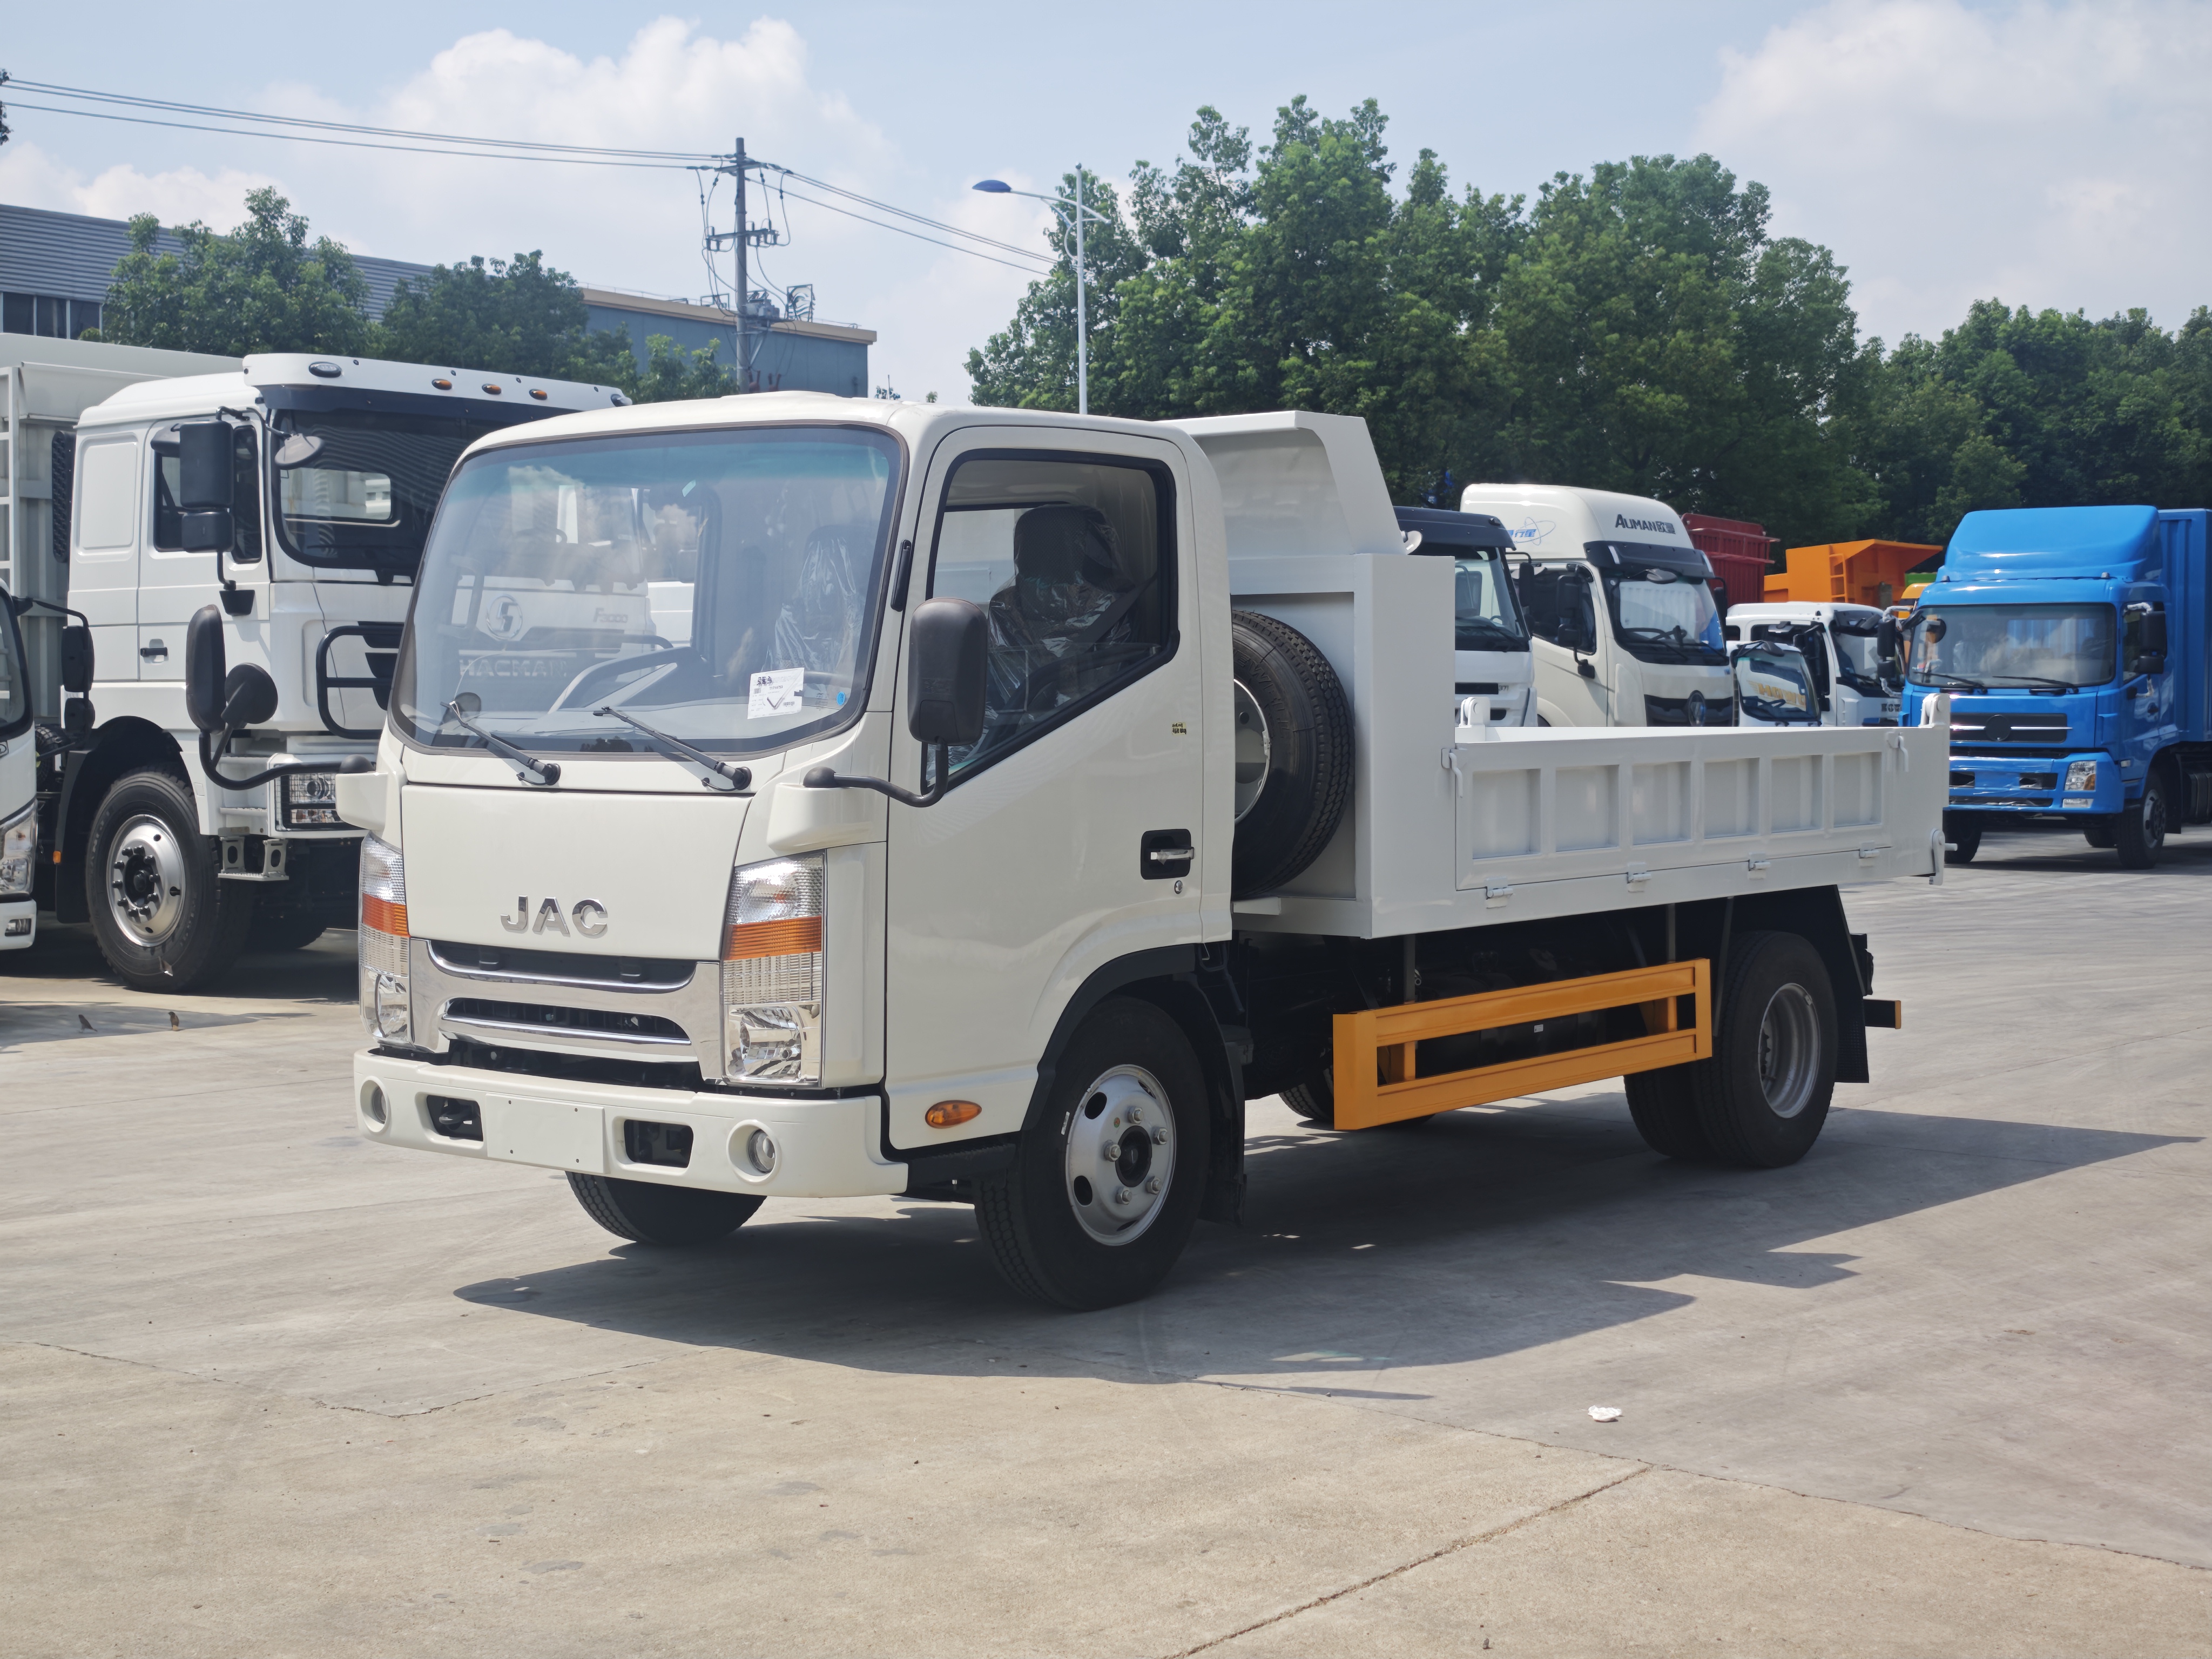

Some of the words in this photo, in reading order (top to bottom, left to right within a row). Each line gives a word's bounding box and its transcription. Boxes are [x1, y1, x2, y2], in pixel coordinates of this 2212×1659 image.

[1615, 514, 1657, 532] AUMAN
[460, 659, 567, 677] HACMAN
[1881, 703, 1900, 712] HOW
[501, 895, 608, 938] JAC
